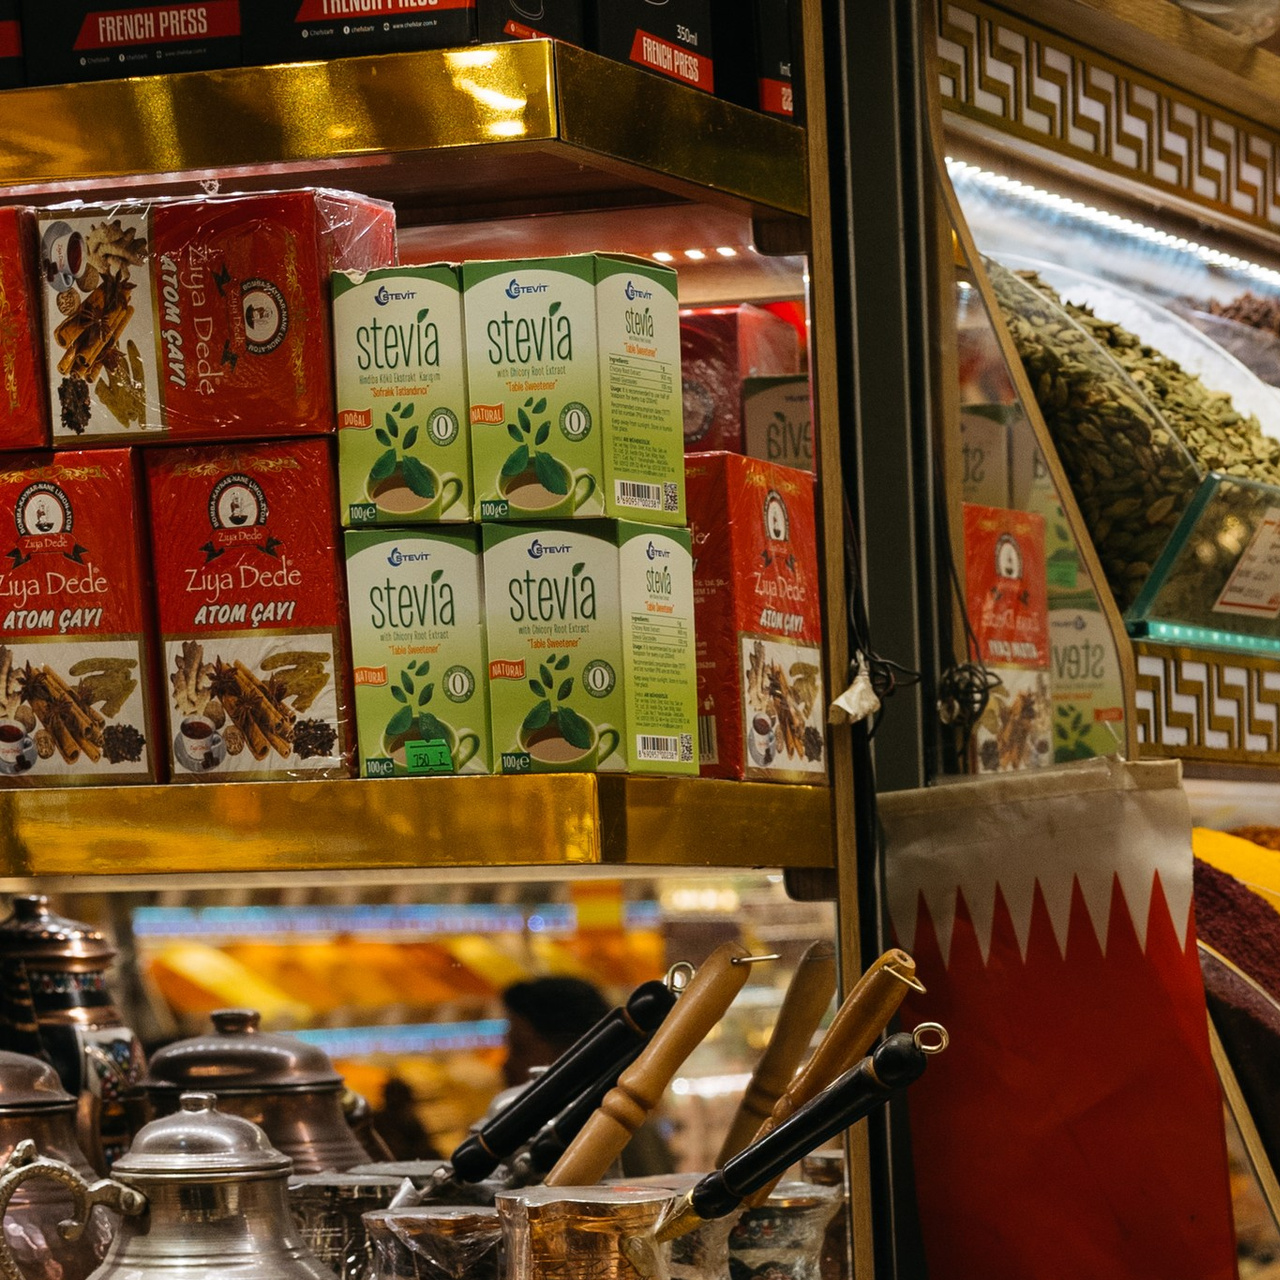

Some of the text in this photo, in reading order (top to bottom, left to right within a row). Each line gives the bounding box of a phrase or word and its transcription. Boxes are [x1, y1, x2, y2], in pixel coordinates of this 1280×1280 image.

[99, 7, 208, 42] FRENCH PRESS
[676, 24, 698, 46] 350ml
[642, 36, 699, 82] FRENCH PRESS
[160, 253, 187, 387] ATOM ÇAYI
[487, 302, 573, 364] stevia
[625, 308, 654, 337] stevia
[356, 309, 440, 370] stevia
[193, 317, 224, 396] Dede
[344, 412, 366, 427] DOĞAL
[471, 408, 502, 421] NATURAL
[46, 562, 109, 595] Dede
[184, 555, 302, 603] Ziya Dede
[508, 562, 597, 622] stevia
[646, 566, 672, 595] stevia
[754, 571, 778, 609] Ziya
[778, 573, 806, 603] Dede
[194, 601, 296, 628] ATOM ÇAYI
[370, 570, 455, 629] stevia
[3, 607, 104, 634] ATOM ÇAYI
[760, 608, 804, 635] ATOM ÇAYI
[355, 670, 385, 683] NATURAL
[492, 665, 523, 677] NATURAL
